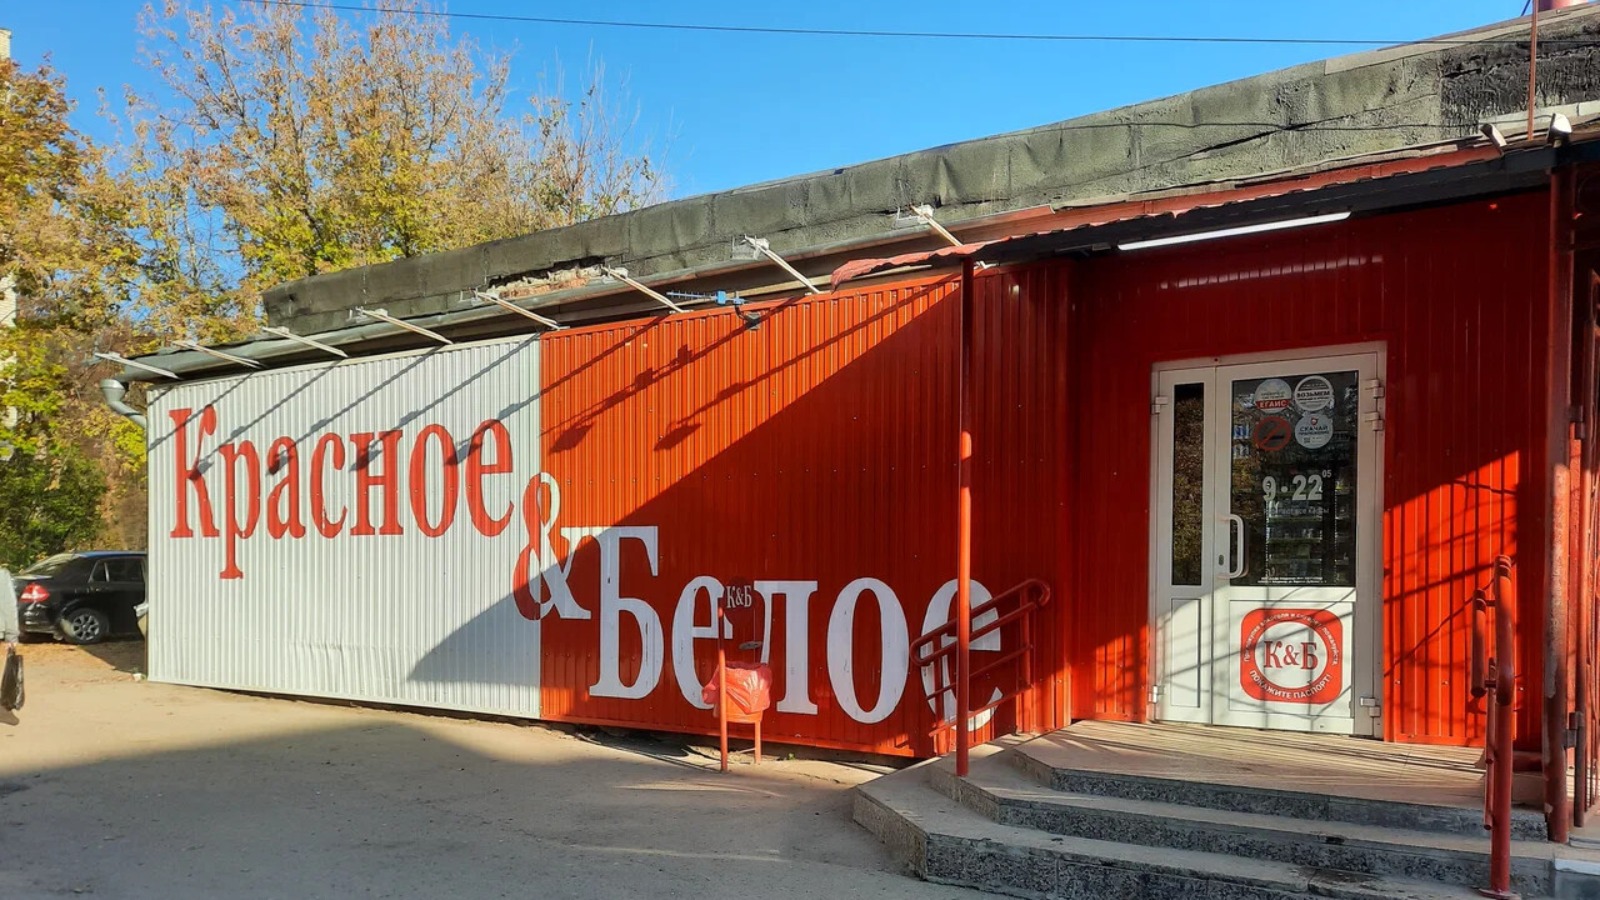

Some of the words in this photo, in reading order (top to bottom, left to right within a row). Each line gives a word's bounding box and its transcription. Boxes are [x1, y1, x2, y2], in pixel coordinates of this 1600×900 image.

[1259, 399, 1287, 408] ЕГАИС
[169, 404, 514, 579] Красное
[512, 472, 596, 620] &
[588, 525, 1003, 731] Белое
[726, 585, 752, 608] К&Б
[1263, 640, 1319, 670] К&Б
[1249, 669, 1292, 699] ПОКАЖИТЕ
[1293, 673, 1333, 699] ПАСПОРТ!
